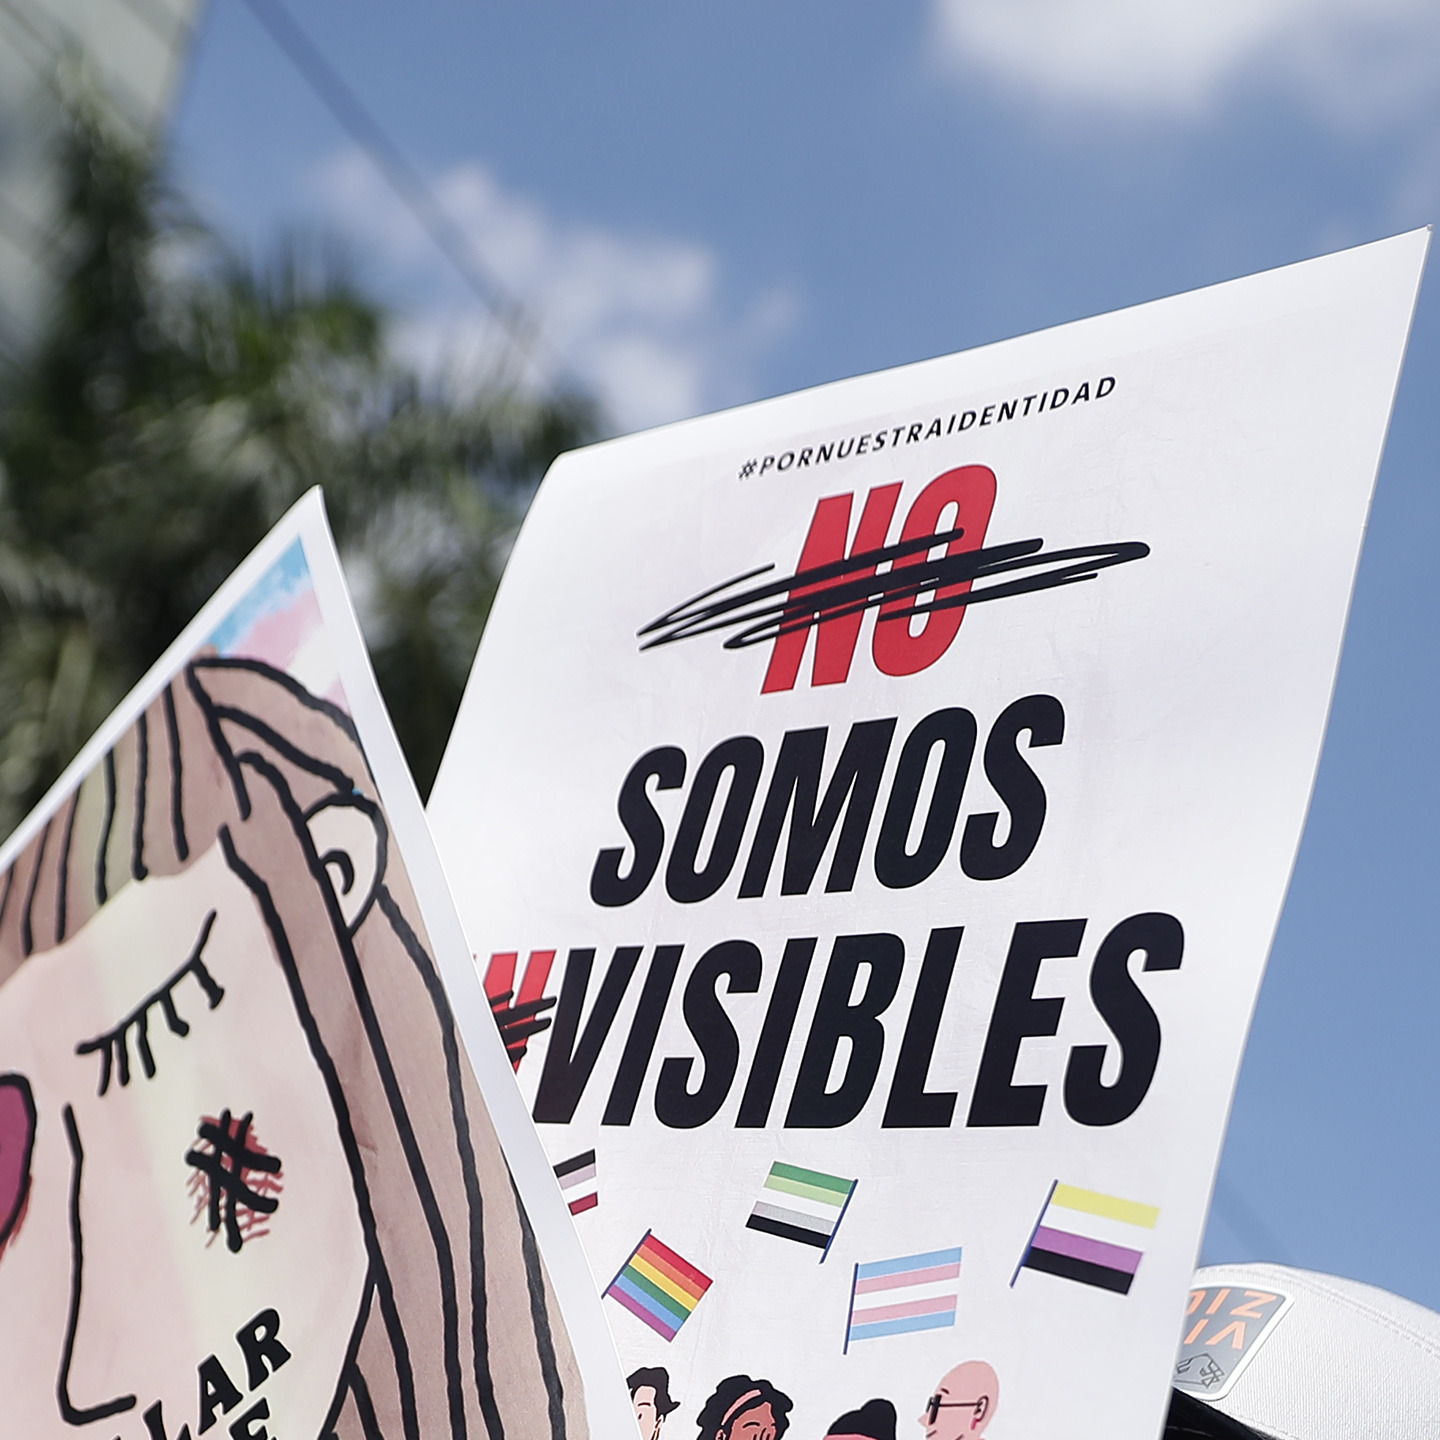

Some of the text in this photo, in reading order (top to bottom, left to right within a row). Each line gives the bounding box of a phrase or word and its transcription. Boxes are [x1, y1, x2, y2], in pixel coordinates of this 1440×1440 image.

[738, 376, 1117, 481] #PORNUESTRAIDENTIDAD
[761, 464, 997, 695] NO
[590, 694, 1065, 908] SOMOS
